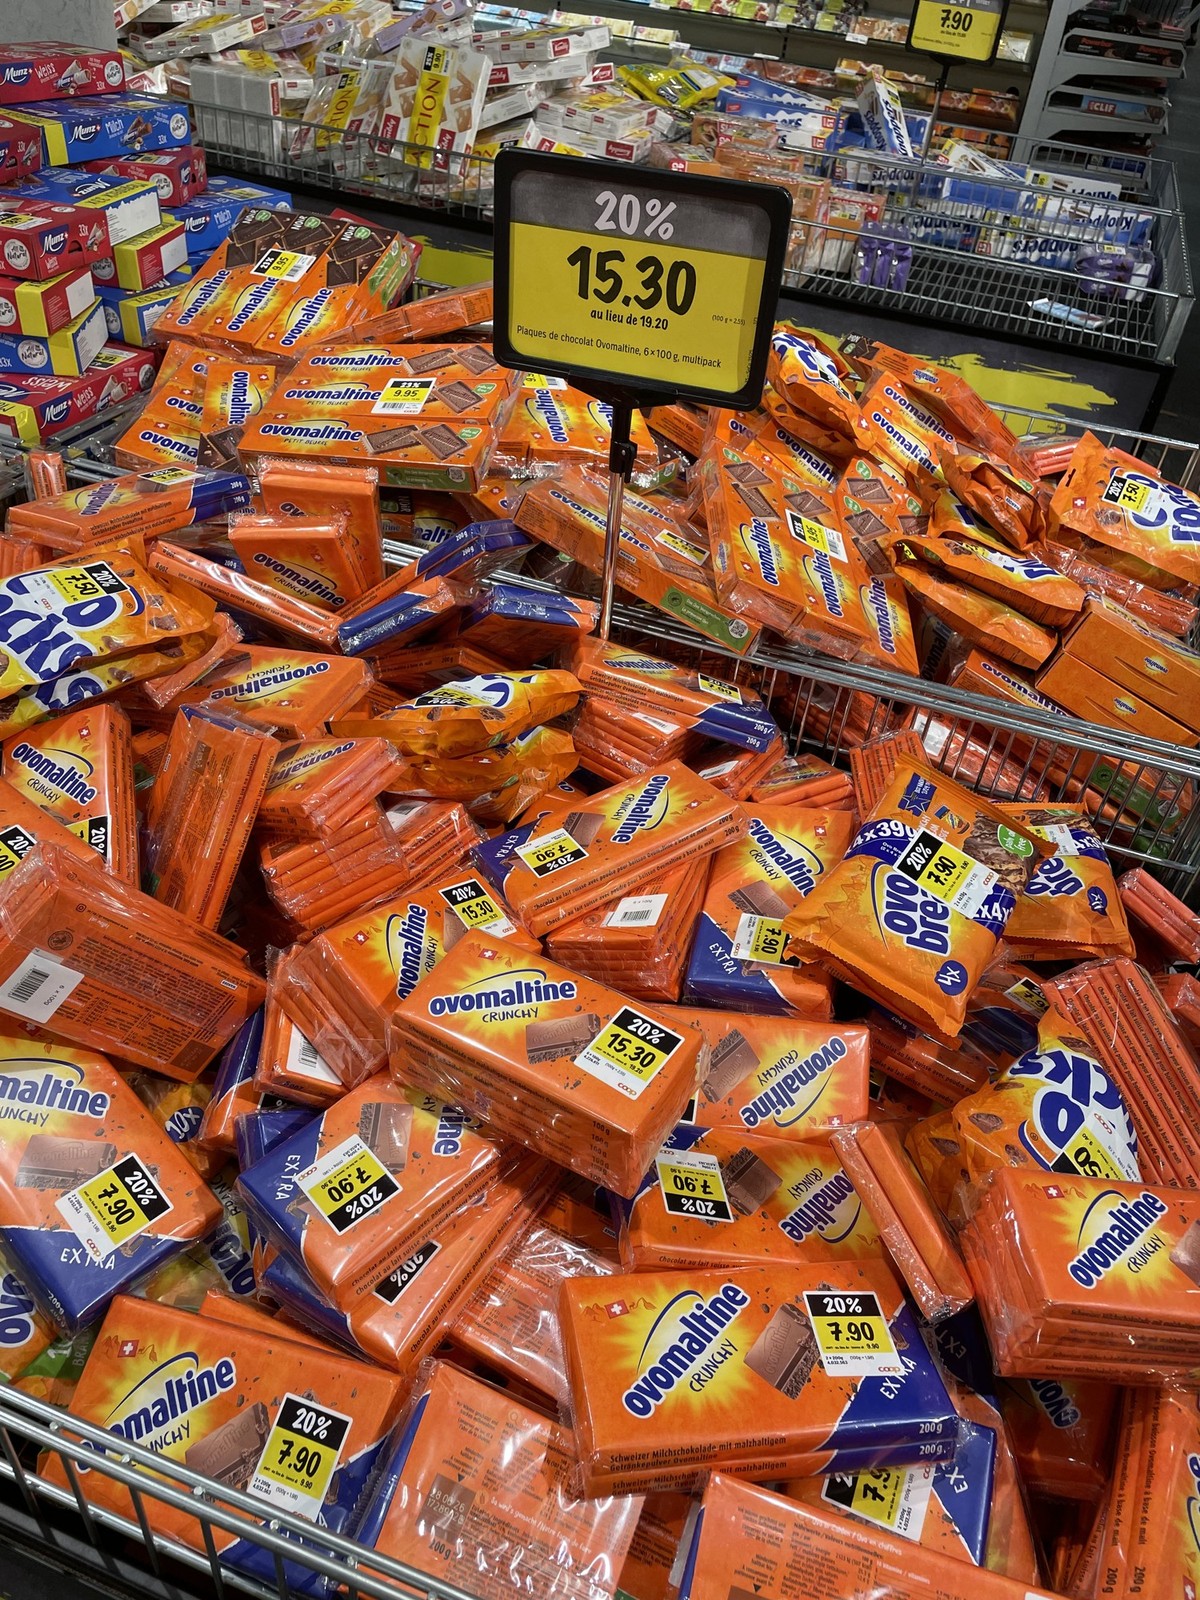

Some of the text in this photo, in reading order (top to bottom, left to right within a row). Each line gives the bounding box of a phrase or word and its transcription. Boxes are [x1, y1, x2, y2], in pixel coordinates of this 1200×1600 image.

[941, 9, 973, 31] 7.90
[1, 67, 28, 85] Munz
[35, 63, 56, 79] Weiss
[69, 124, 96, 144] Munz
[105, 119, 124, 134] Milch
[185, 216, 206, 232] Munz
[215, 209, 231, 224] Milch
[594, 190, 678, 240] 20%
[41, 235, 64, 257] Munz
[271, 256, 289, 272] 9.95
[566, 245, 697, 316] 15.30
[177, 269, 231, 326] ovomaltine
[227, 277, 278, 332] ovomaltine
[280, 288, 333, 346] ovomaltine
[590, 310, 669, 331] au lieu de 19.20
[516, 324, 547, 339] Plaques
[549, 330, 559, 341] de
[561, 332, 594, 348] chocolat
[595, 339, 642, 357] Ovomaltine,
[681, 354, 722, 369] multipack
[311, 354, 403, 367] ovomaltine
[74, 388, 94, 408] Weiss
[229, 370, 249, 425] ovomaltine
[286, 388, 380, 400] ovomaltine
[393, 389, 418, 398] 9.95
[41, 402, 67, 429] Munz
[536, 389, 569, 442] ovomaltine
[883, 386, 955, 443] ovomaltine
[261, 424, 363, 441] ovomaltine
[1108, 480, 1123, 496] 20%
[1121, 483, 1140, 502] 7.50
[752, 519, 778, 585] ovomaltine
[64, 574, 100, 596] 7.50
[93, 570, 119, 588] 20%
[254, 553, 346, 606] ovomaltine
[274, 577, 310, 599] CRUNCHY
[814, 549, 843, 617] ovomaltine
[871, 577, 896, 653] ovomaltine
[246, 663, 291, 680] CRUNCHY
[604, 659, 678, 670] ovomaltine
[211, 662, 330, 700] ovomaltine
[746, 737, 760, 747] 200g
[13, 743, 96, 805] ovomaltine
[26, 778, 61, 803] CRUNCHY
[611, 793, 635, 821] CRUNCHY
[612, 775, 670, 843] ovomaltine
[724, 826, 739, 836] 200g
[495, 835, 519, 859] EXTRA
[536, 845, 570, 863] 7.90
[906, 842, 932, 872] 20%
[546, 855, 575, 871] 20%
[749, 849, 782, 881] CRUNCHY
[926, 856, 957, 885] 7.90
[567, 908, 574, 917] au
[575, 903, 583, 913] lait
[583, 898, 599, 909] suisse
[600, 892, 610, 901] avec
[610, 883, 627, 896] poudre
[627, 877, 638, 887] pour
[638, 868, 656, 882] boisson
[656, 855, 682, 873] Ovomaltine
[686, 846, 698, 856] base
[704, 838, 715, 848] malt
[983, 872, 994, 886] coop
[452, 886, 476, 901] 20%
[461, 900, 494, 921] 15.30
[709, 943, 739, 975] EXTRA
[733, 943, 741, 955] coop
[430, 981, 576, 1016] ovomaltine
[482, 1008, 539, 1024] CRUNCHY
[628, 1018, 665, 1044] 20%
[607, 1033, 656, 1068] 15.30
[740, 1036, 847, 1127] ovomaltine
[757, 1050, 799, 1087] CRUNCHY
[618, 1083, 637, 1096] coop
[275, 1155, 300, 1200] EXTRA
[298, 1167, 317, 1181] coop
[327, 1167, 372, 1202] 7.90
[673, 1174, 714, 1195] 7.90
[787, 1167, 823, 1200] CRUNCHY
[125, 1171, 157, 1205] 20%
[98, 1183, 135, 1225] 7.90
[345, 1186, 382, 1219] 20%
[681, 1197, 716, 1215] 20%
[351, 1263, 378, 1287] Chocolat
[431, 1200, 454, 1220] poudre
[451, 1188, 465, 1204] pour
[464, 1170, 486, 1189] boisson
[1069, 1193, 1167, 1288] ovomaltine
[356, 1227, 434, 1295] Chocolat au lait suisse avec
[1126, 1233, 1166, 1274] CRUNCHY
[411, 1234, 500, 1353] Chocolat au lait suisse avec poudre pour
[823, 1297, 862, 1314] 20%
[827, 1322, 874, 1341] 7.90
[622, 1284, 749, 1418] ovomaltine
[689, 1338, 739, 1393] CRUNCHY
[292, 1407, 332, 1440] 20%
[919, 1422, 943, 1435] 200g
[278, 1439, 321, 1478] 7.90
[610, 1437, 786, 1464] Schweizer Milchschokolade mit malzhaltigem
[919, 1444, 943, 1457] 200g
[612, 1478, 651, 1489] Schweizer
[734, 1461, 787, 1473] malzhaltigem
